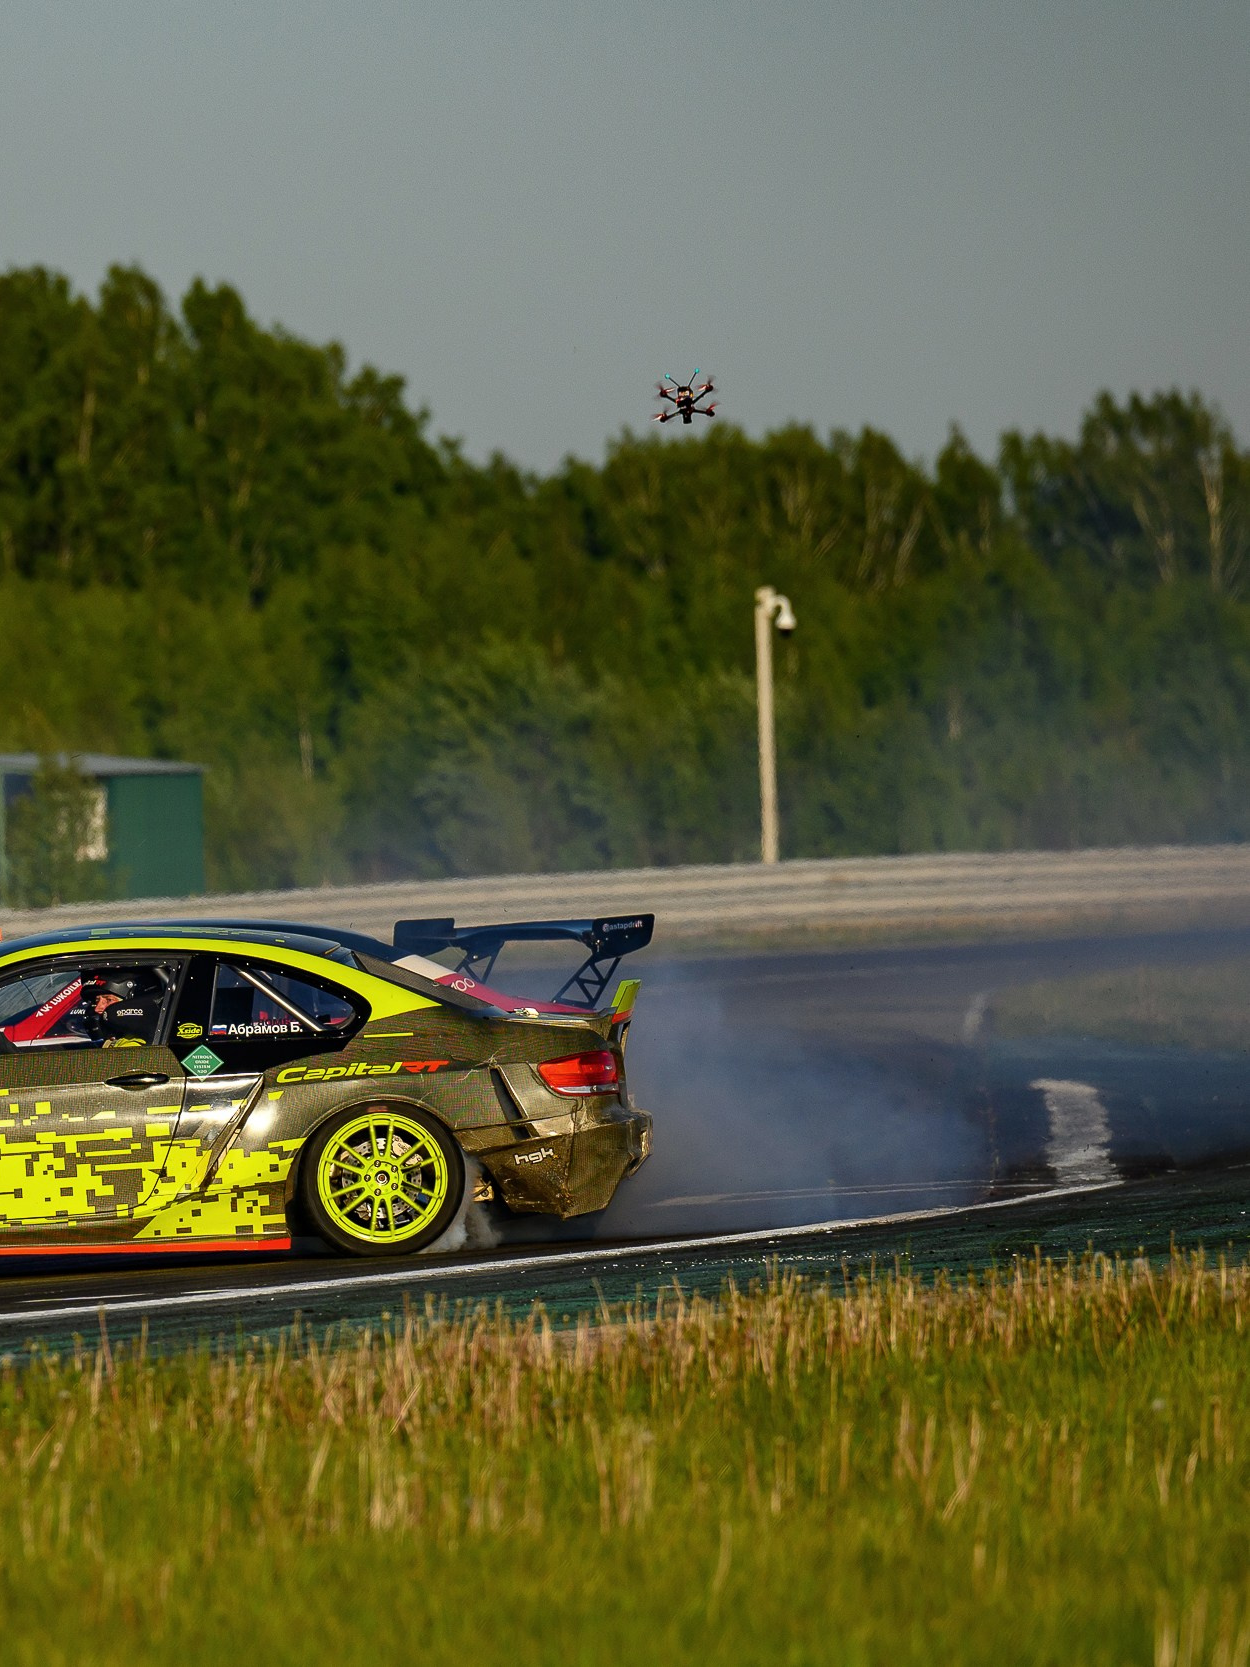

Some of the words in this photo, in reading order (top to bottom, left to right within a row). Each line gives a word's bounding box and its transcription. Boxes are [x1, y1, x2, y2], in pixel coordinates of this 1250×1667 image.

[116, 1008, 144, 1016] sparco
[228, 1023, 288, 1037] Абрамов
[290, 1021, 303, 1033] Б.
[514, 1147, 554, 1165] hgk
